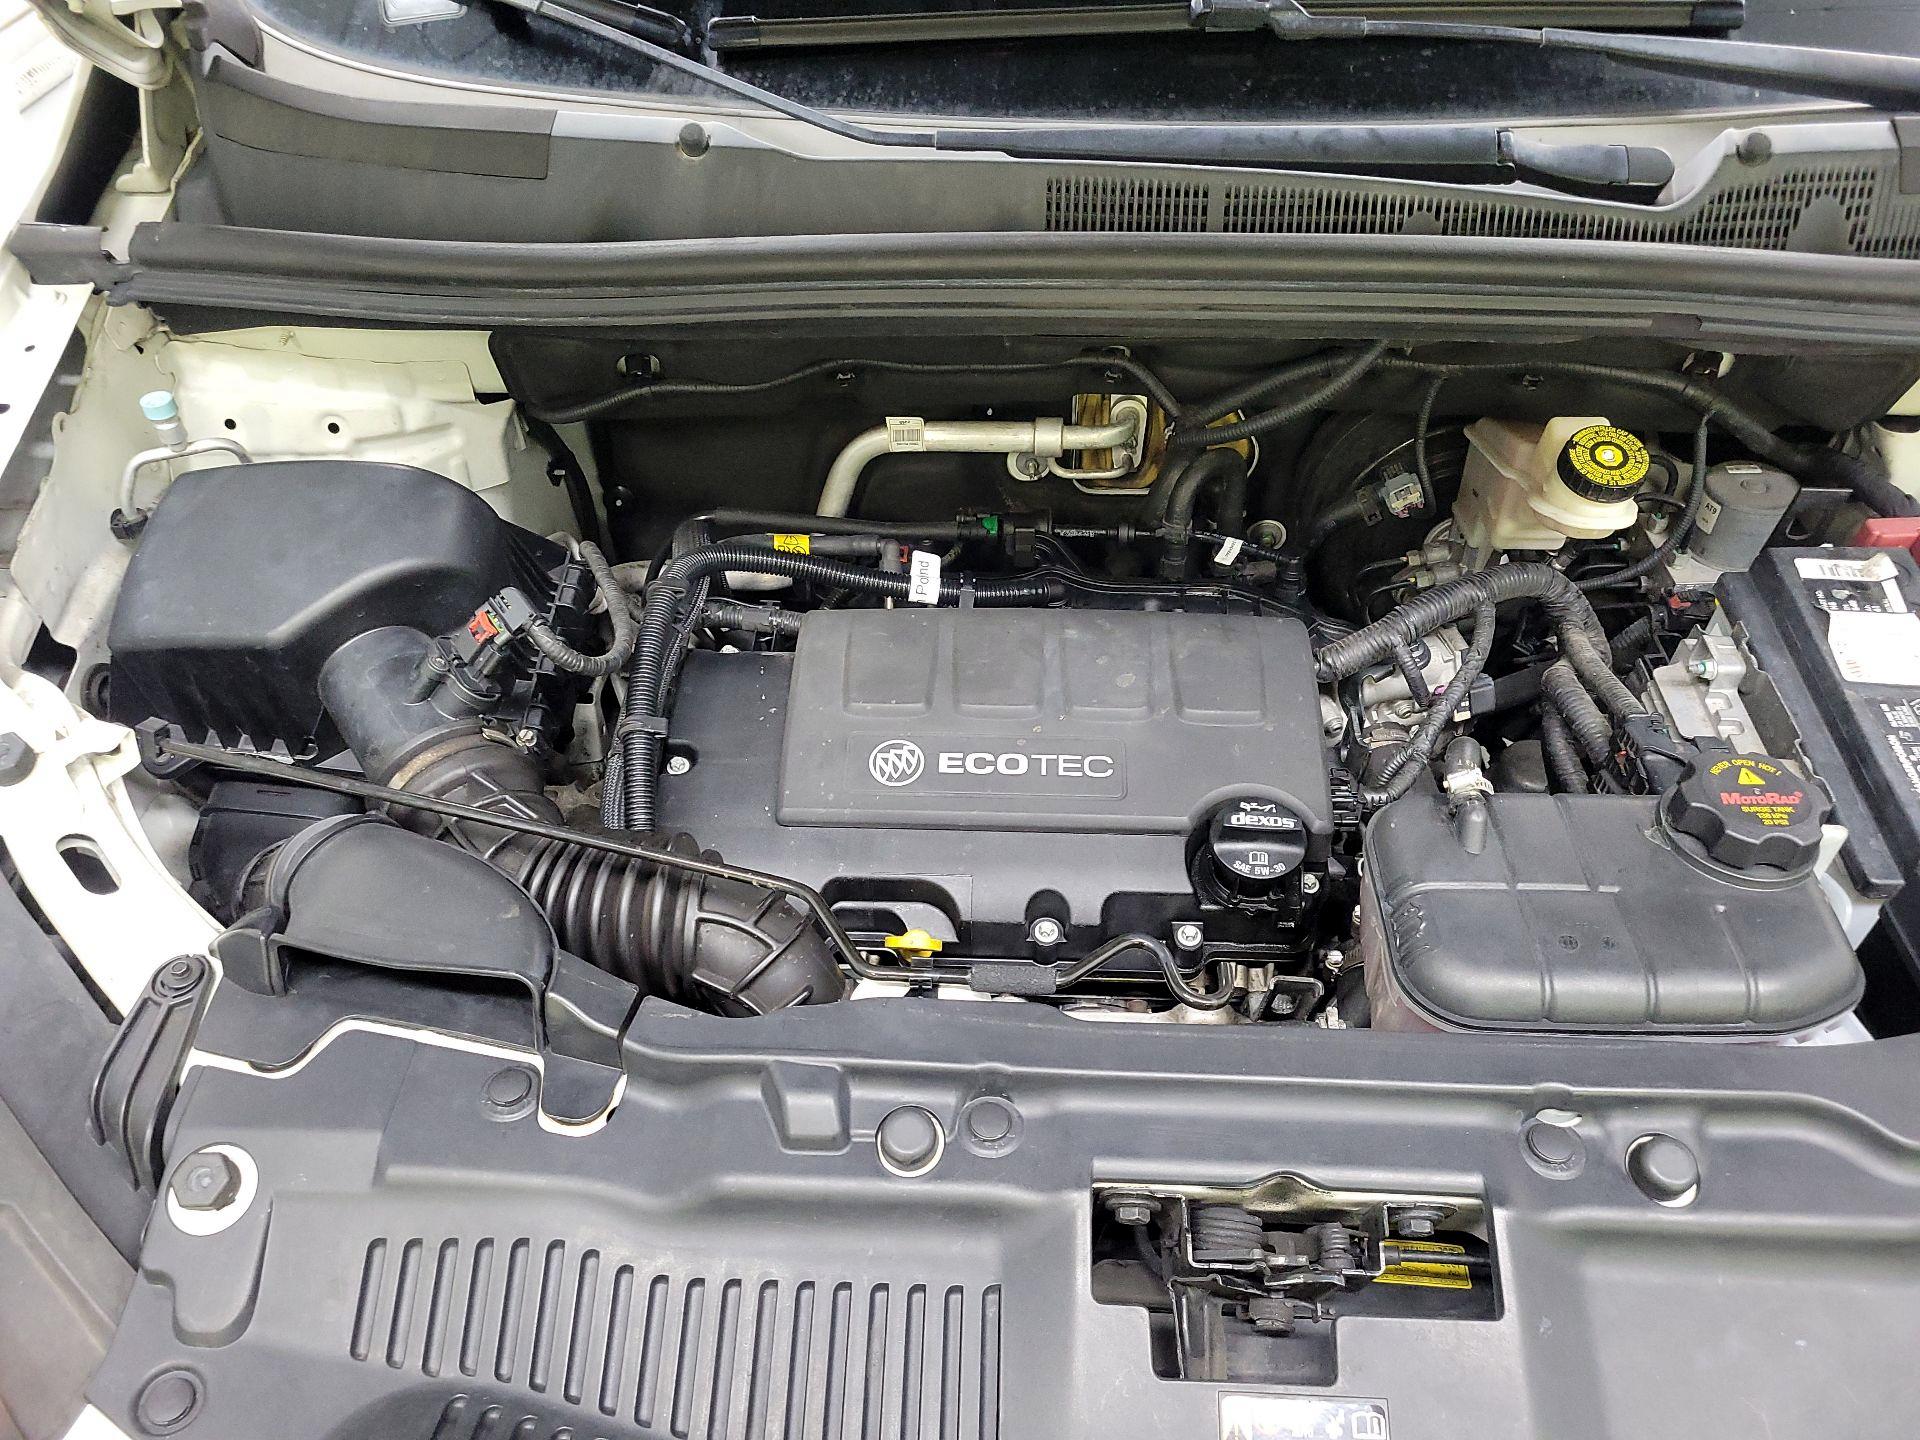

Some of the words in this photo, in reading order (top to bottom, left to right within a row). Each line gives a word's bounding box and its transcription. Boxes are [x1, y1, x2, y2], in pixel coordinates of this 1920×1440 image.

[1704, 502, 1718, 514] AT9
[938, 752, 1115, 778] ECOTEC
[1710, 760, 1732, 776] NEVER
[1731, 759, 1755, 767] OPEN
[1758, 763, 1776, 773] HOT
[1230, 811, 1298, 829] dexos
[1233, 860, 1252, 874] SAE
[1254, 862, 1286, 876] 5W-30
